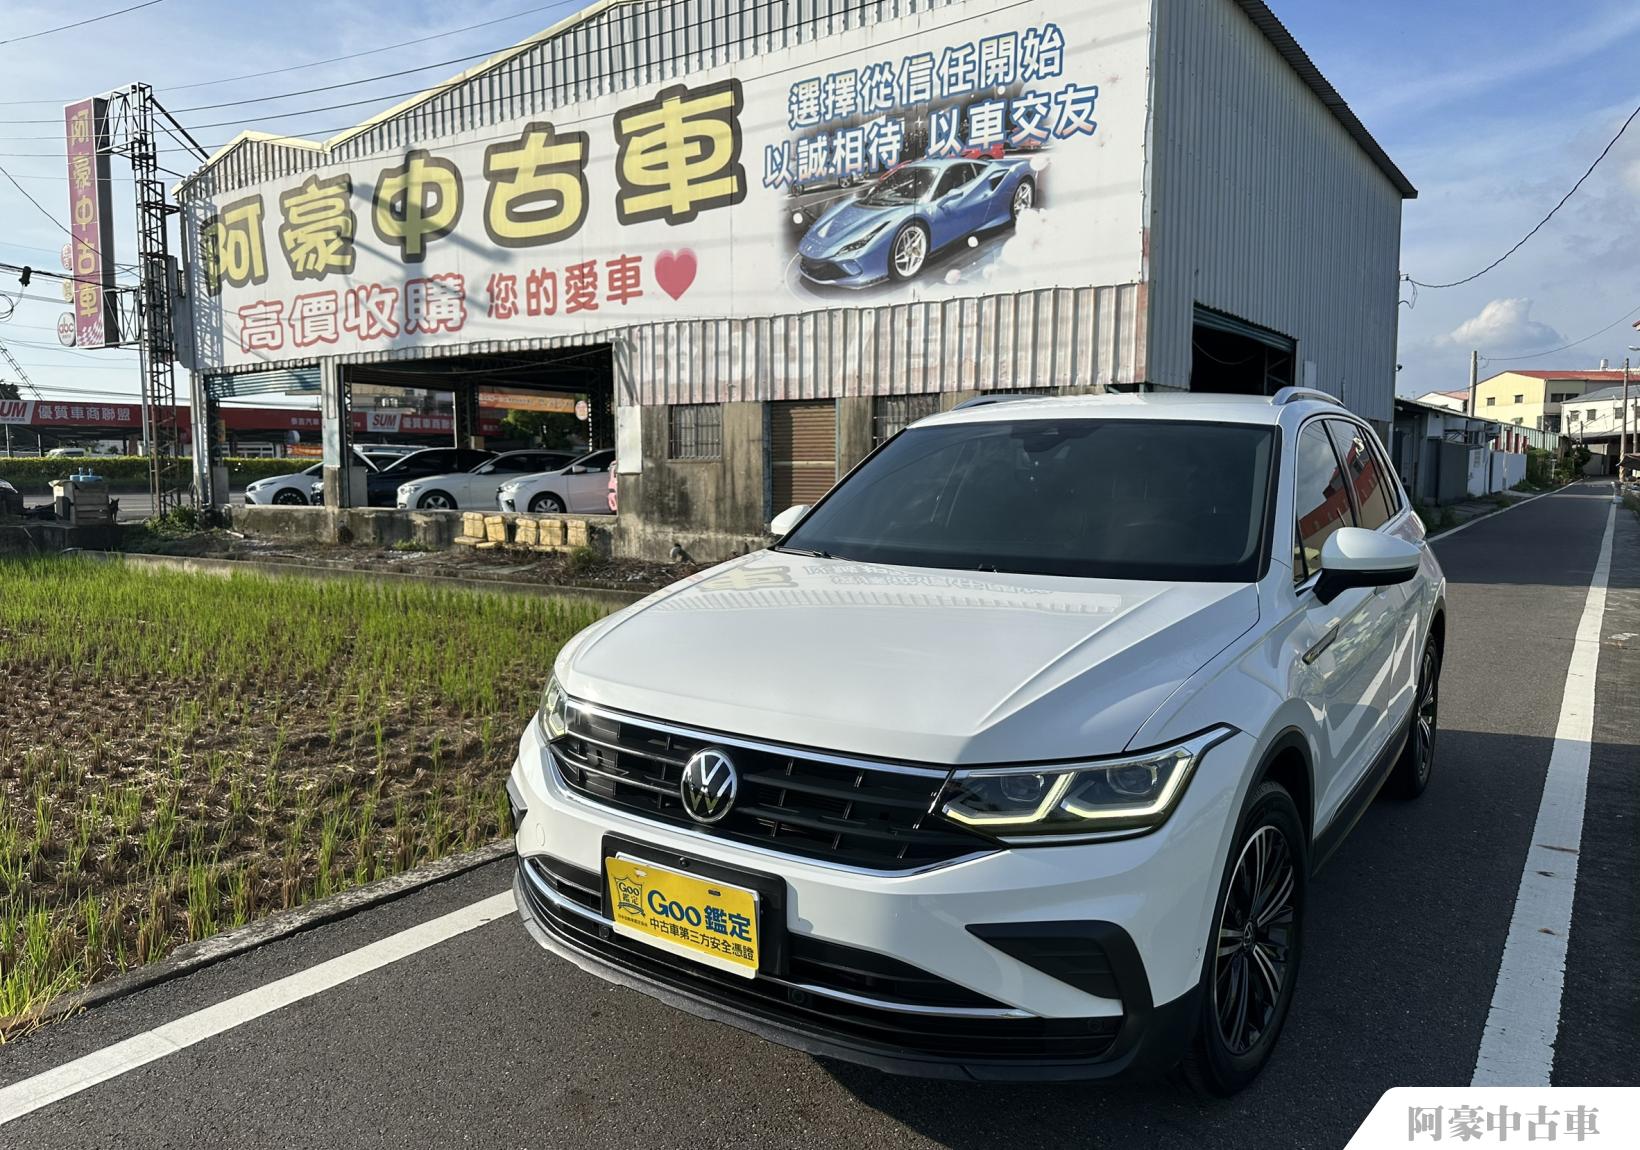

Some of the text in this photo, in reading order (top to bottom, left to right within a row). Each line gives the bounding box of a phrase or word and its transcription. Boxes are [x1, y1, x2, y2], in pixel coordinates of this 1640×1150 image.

[788, 24, 1065, 130] 選擇從信任開始
[763, 84, 1098, 189] 以誠相待 以車交友
[71, 108, 98, 317] 阿豪中古車
[200, 79, 747, 296] 阿豪中古車
[239, 254, 643, 353] 高價收購 您的愛車
[0, 401, 27, 417] UM
[39, 404, 131, 421] 優質車商聯盟
[372, 414, 397, 427] SUM
[647, 890, 752, 942] Goo 鑑定
[650, 917, 755, 961] 中古車第三方安全憑證
